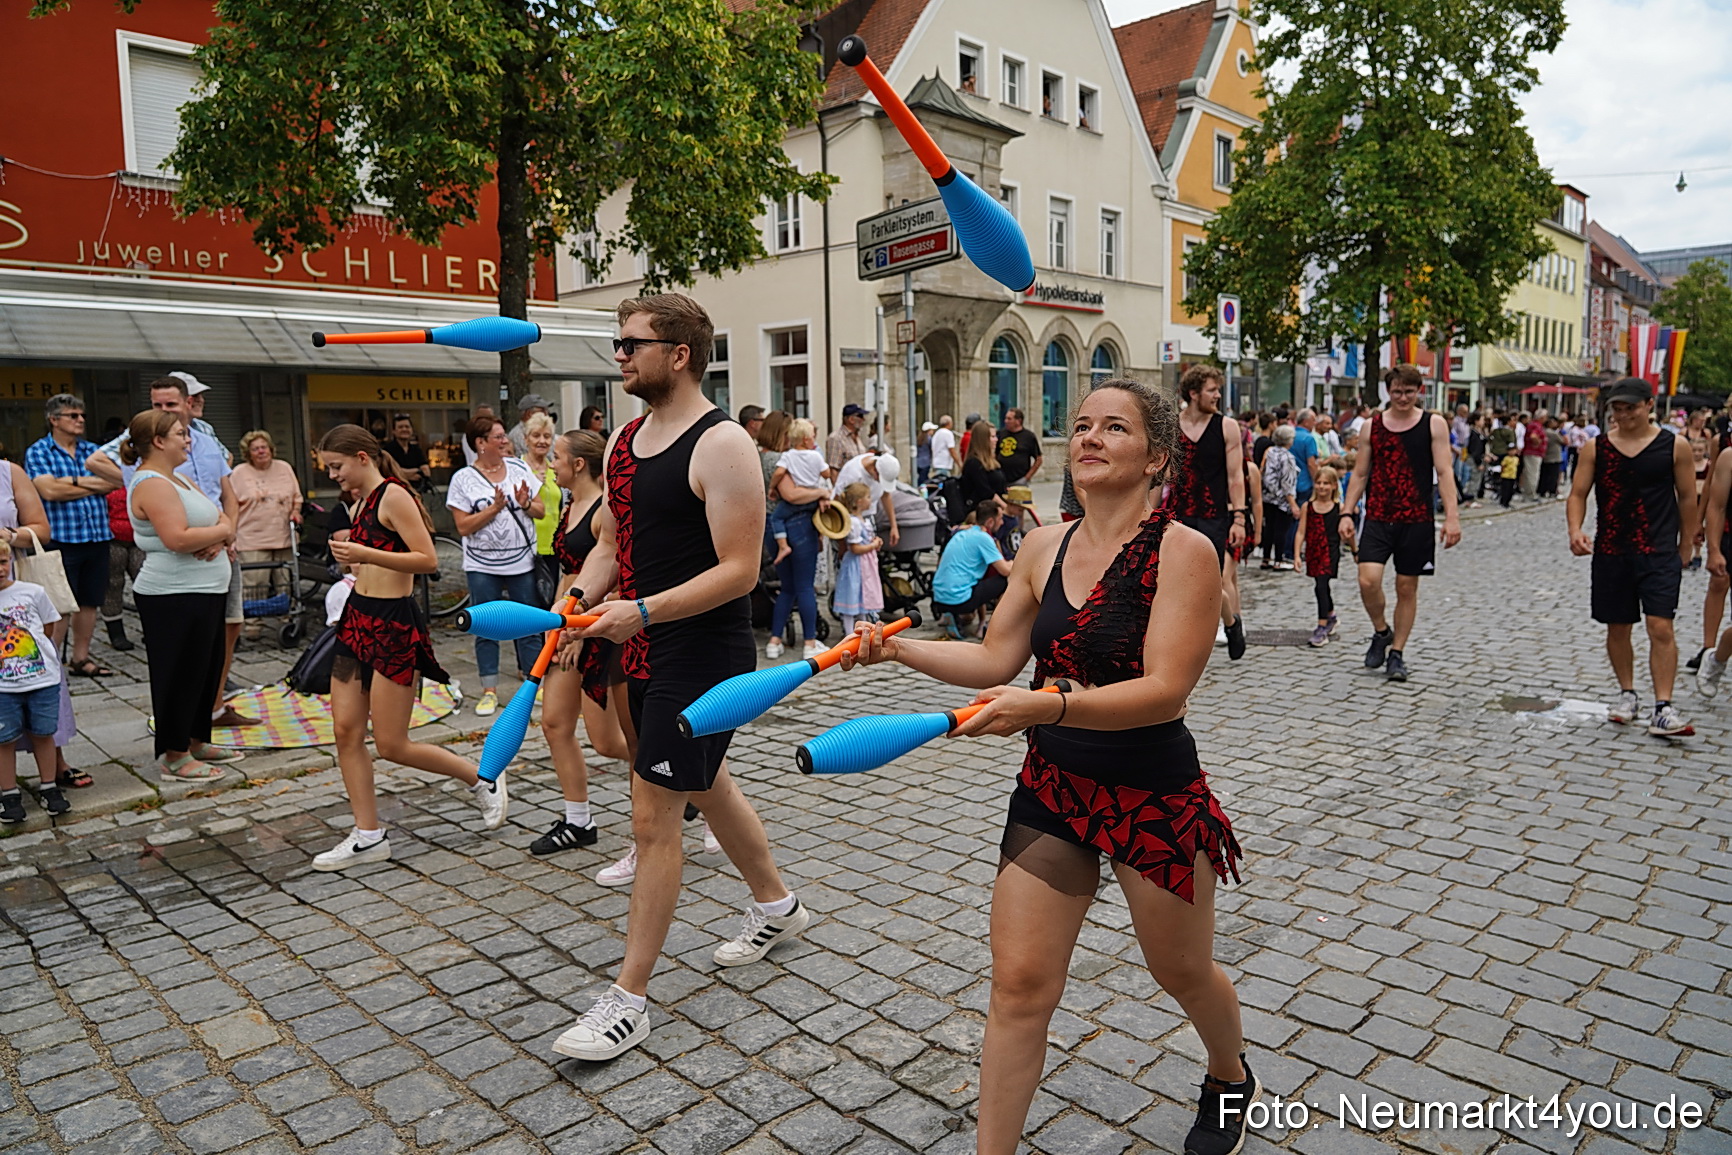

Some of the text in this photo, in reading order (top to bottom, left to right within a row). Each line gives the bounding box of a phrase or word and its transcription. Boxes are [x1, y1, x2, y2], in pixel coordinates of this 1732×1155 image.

[871, 210, 934, 239] Parkleitsystem
[893, 240, 935, 258] Rosengasse
[264, 241, 499, 291] SCHLIER
[1035, 281, 1104, 305] HypoVereinsbank
[377, 388, 467, 401] SCHLIERF
[651, 766, 673, 777] adidas
